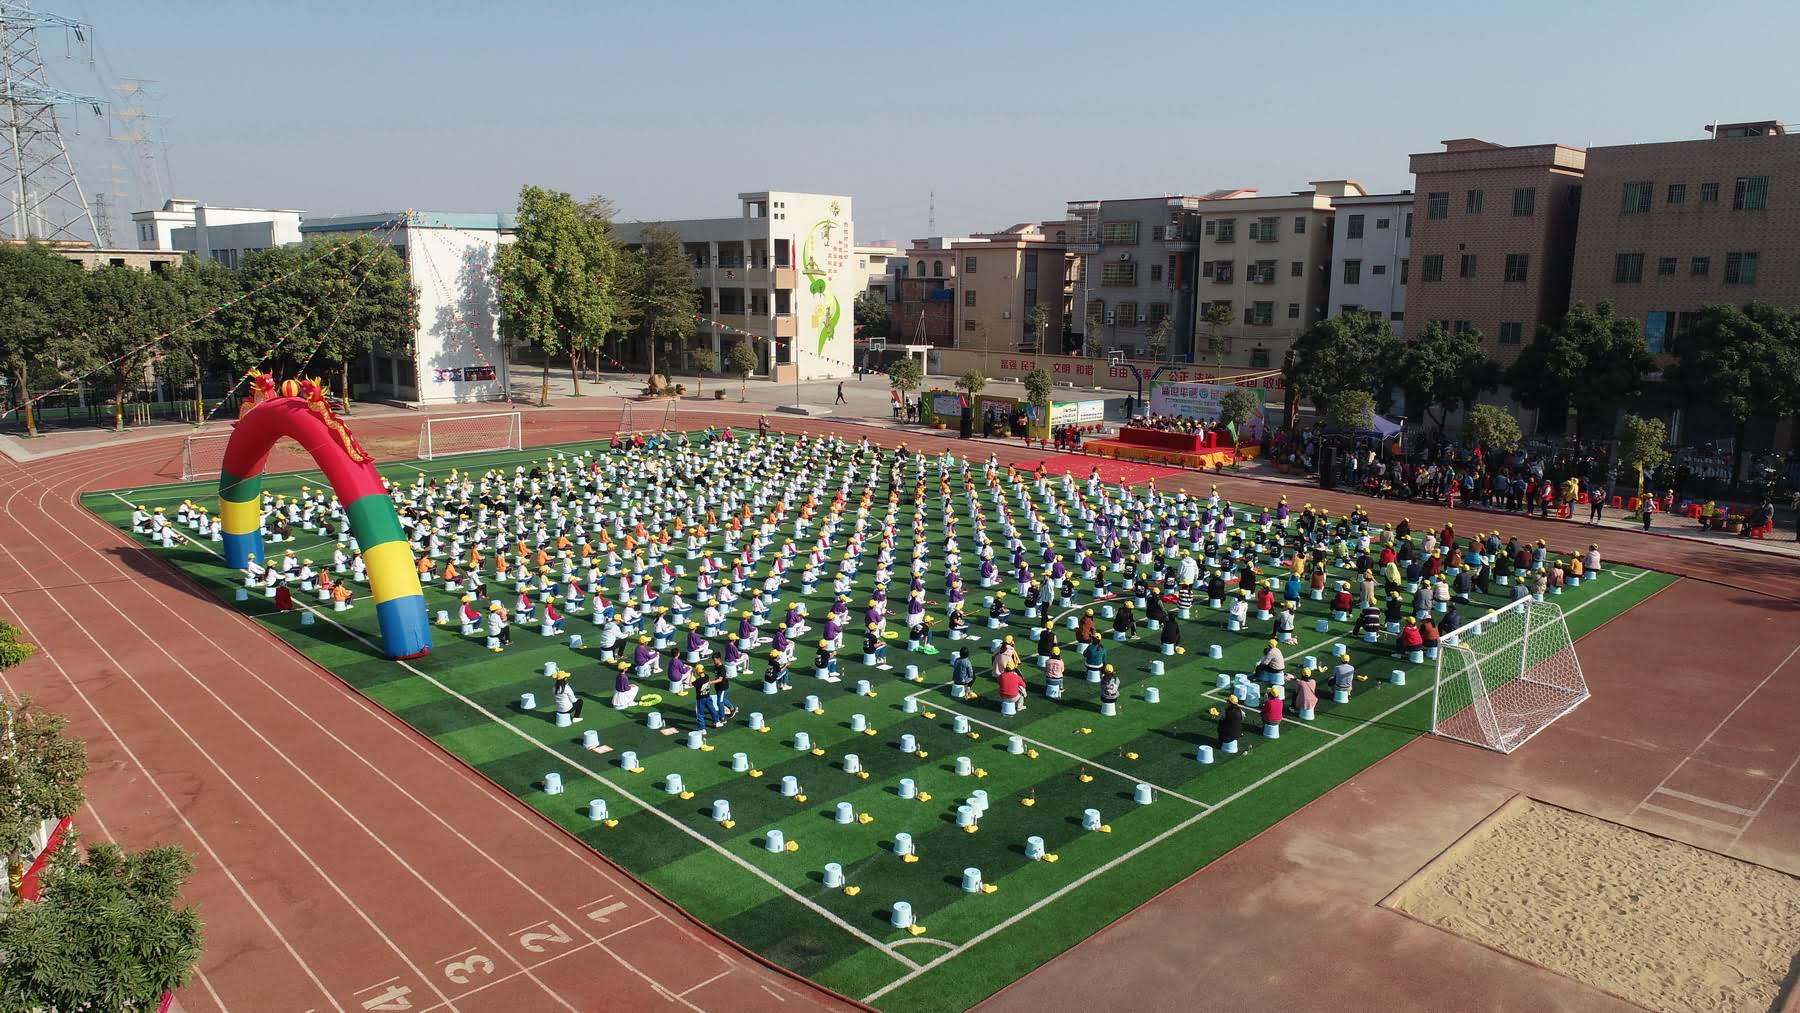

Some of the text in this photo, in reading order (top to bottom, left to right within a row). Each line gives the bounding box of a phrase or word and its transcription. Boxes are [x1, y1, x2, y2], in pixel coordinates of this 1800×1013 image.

[1053, 363, 1071, 374] 文明
[1076, 364, 1094, 376] 和谐
[1109, 367, 1128, 378] 自由
[1168, 371, 1189, 382] 公正
[586, 901, 628, 923] 1
[520, 923, 573, 953] 2
[444, 955, 495, 984] 3
[361, 985, 413, 1011] 4
